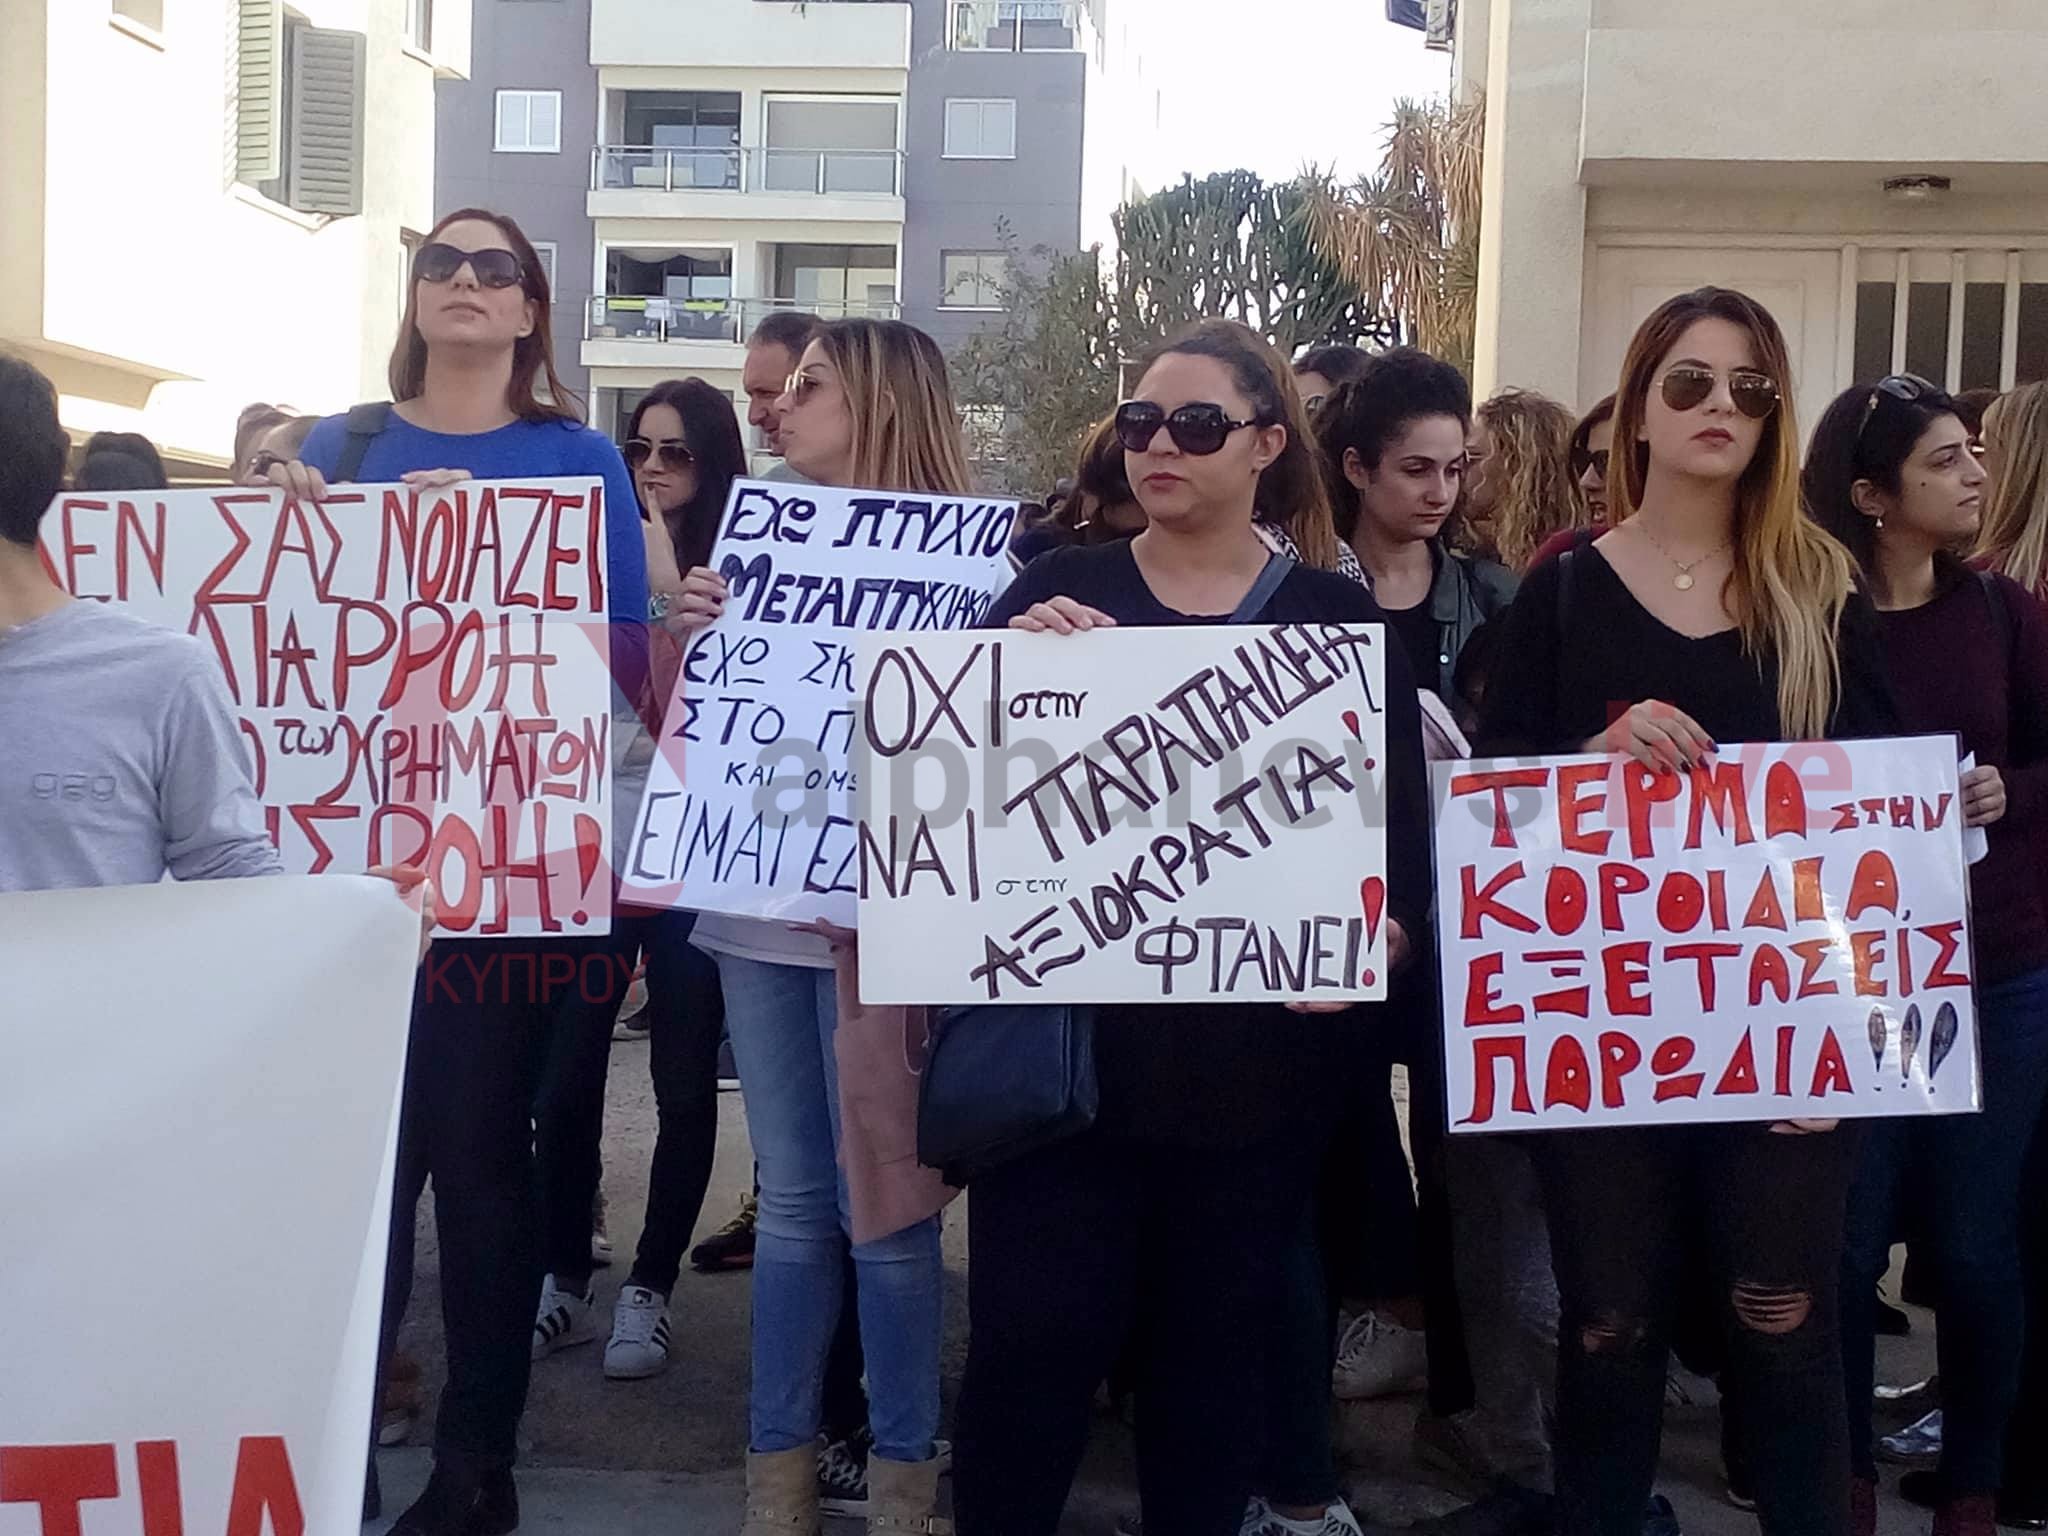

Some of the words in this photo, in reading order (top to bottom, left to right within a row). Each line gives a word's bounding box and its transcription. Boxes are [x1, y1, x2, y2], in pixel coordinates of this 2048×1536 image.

[194, 493, 366, 606] ΣΑΣ
[374, 485, 604, 614] ΝΟΙΑΖΕΙ
[831, 497, 1016, 558] ΠΤΥΧΙΟ
[671, 695, 786, 746] ΣΤΟ
[863, 641, 1003, 758] ΟΧΙ
[724, 761, 776, 788] ΚΑΙ
[1450, 759, 1807, 861] ΤΕΡΜΑ
[1830, 792, 1953, 834] ΣΤΗΝ
[629, 791, 789, 888] ΕΙΜΑΙ
[857, 807, 980, 902] ΝΑΙ
[1133, 874, 1387, 996] ΦΤΑΝΕΙ!
